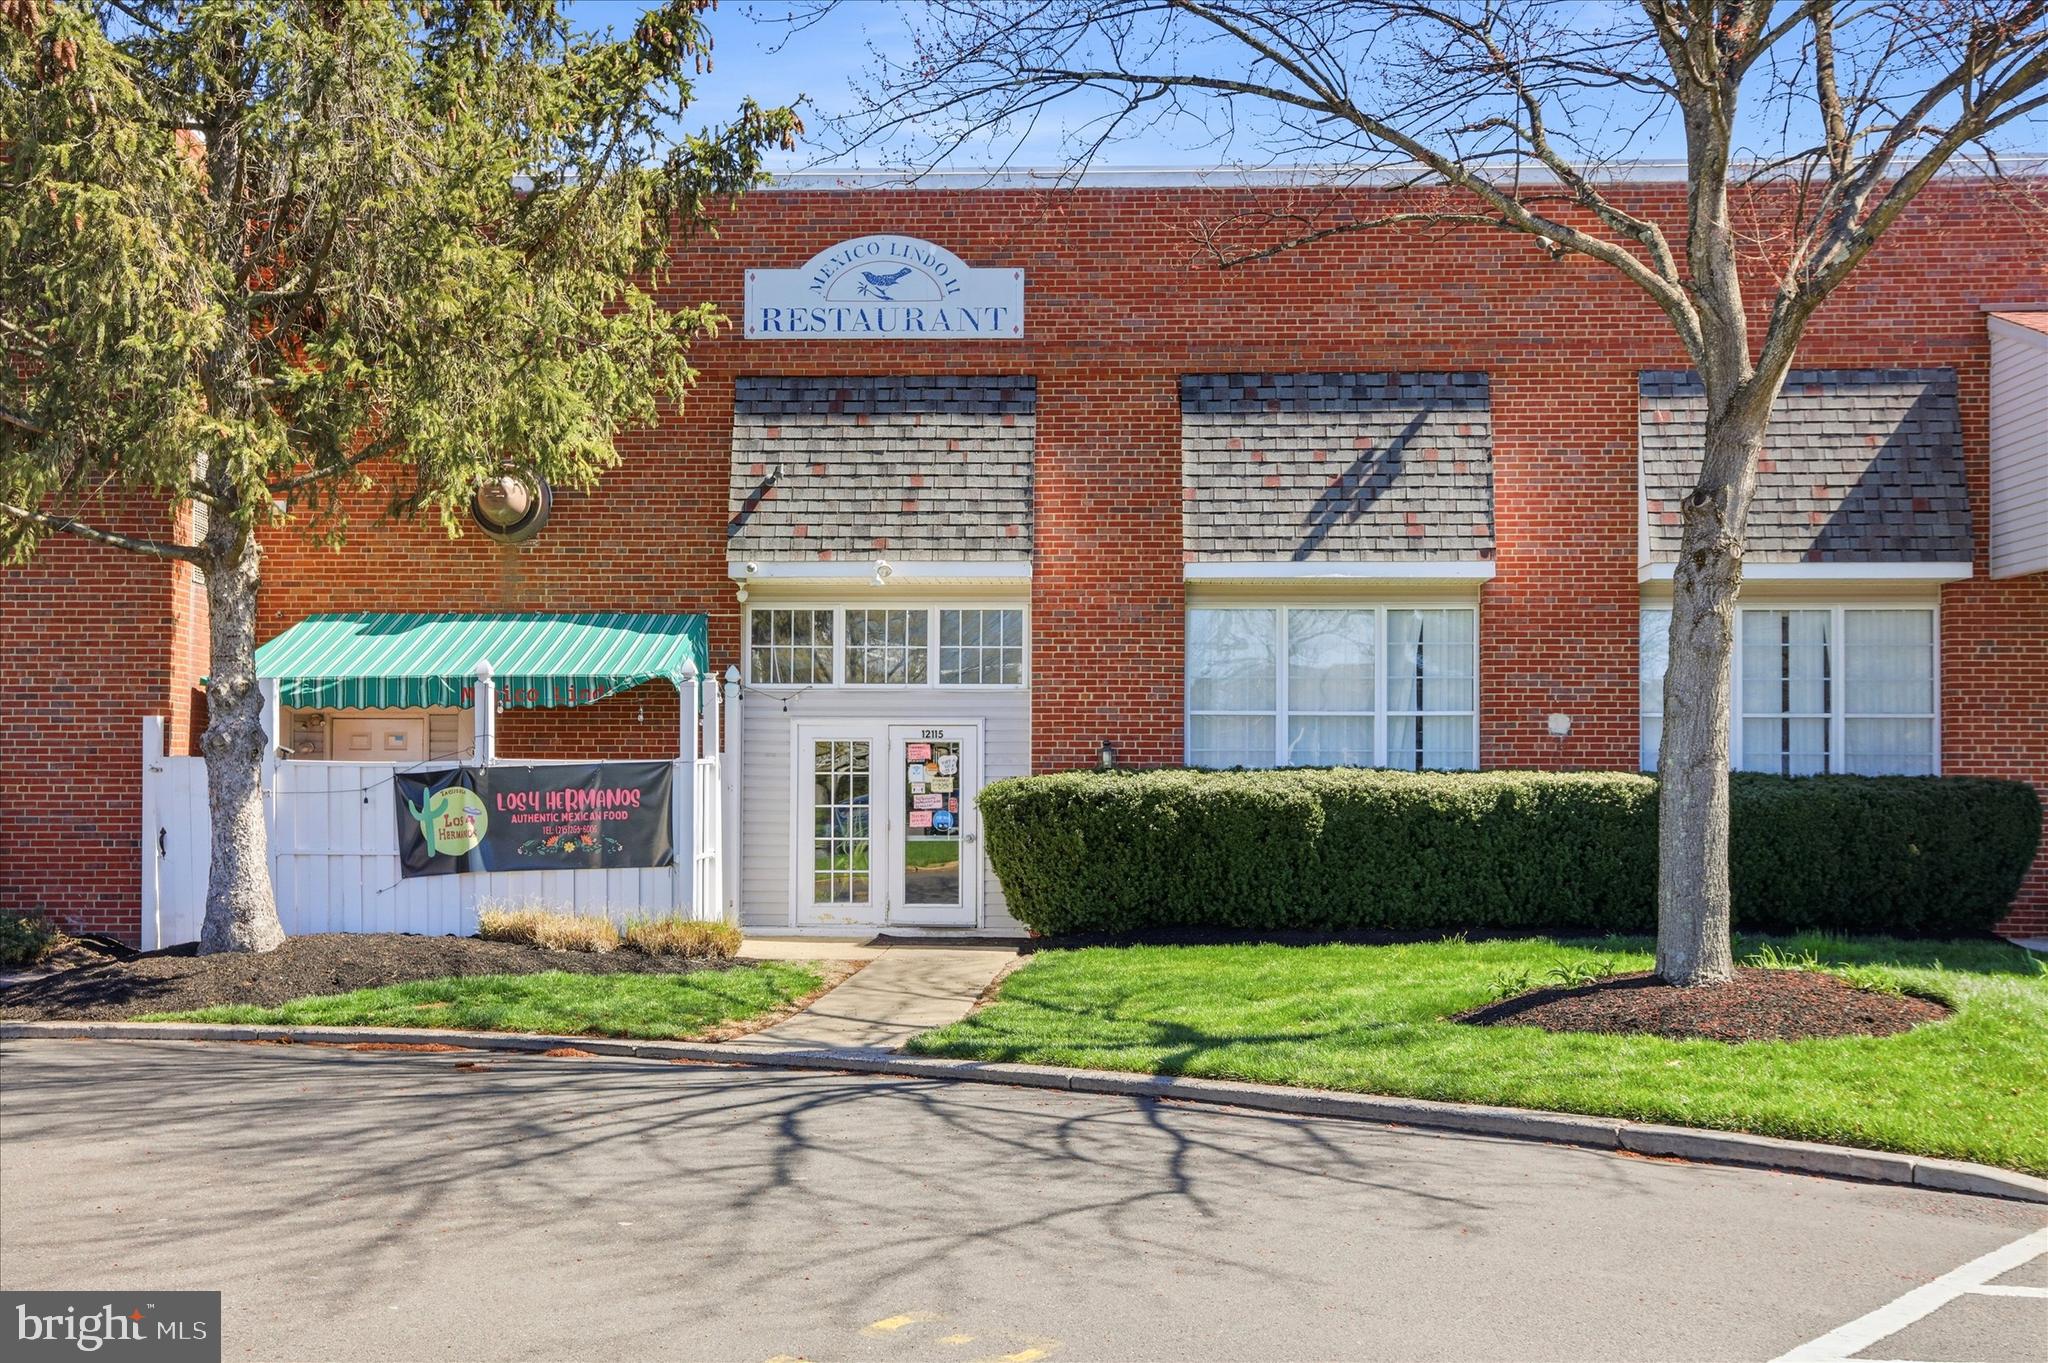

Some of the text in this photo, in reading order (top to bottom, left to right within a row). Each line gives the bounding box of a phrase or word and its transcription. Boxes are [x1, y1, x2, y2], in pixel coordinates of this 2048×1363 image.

[809, 241, 880, 295] MEXICO
[890, 242, 949, 277] LINDO
[760, 307, 1008, 333] RESTAURANT
[461, 685, 540, 703] Mico
[922, 730, 944, 739] 12115
[496, 792, 527, 811] LOS
[546, 788, 641, 812] HERMANOS
[511, 810, 629, 824] AUTHENTIC MEXICAN FOOD
